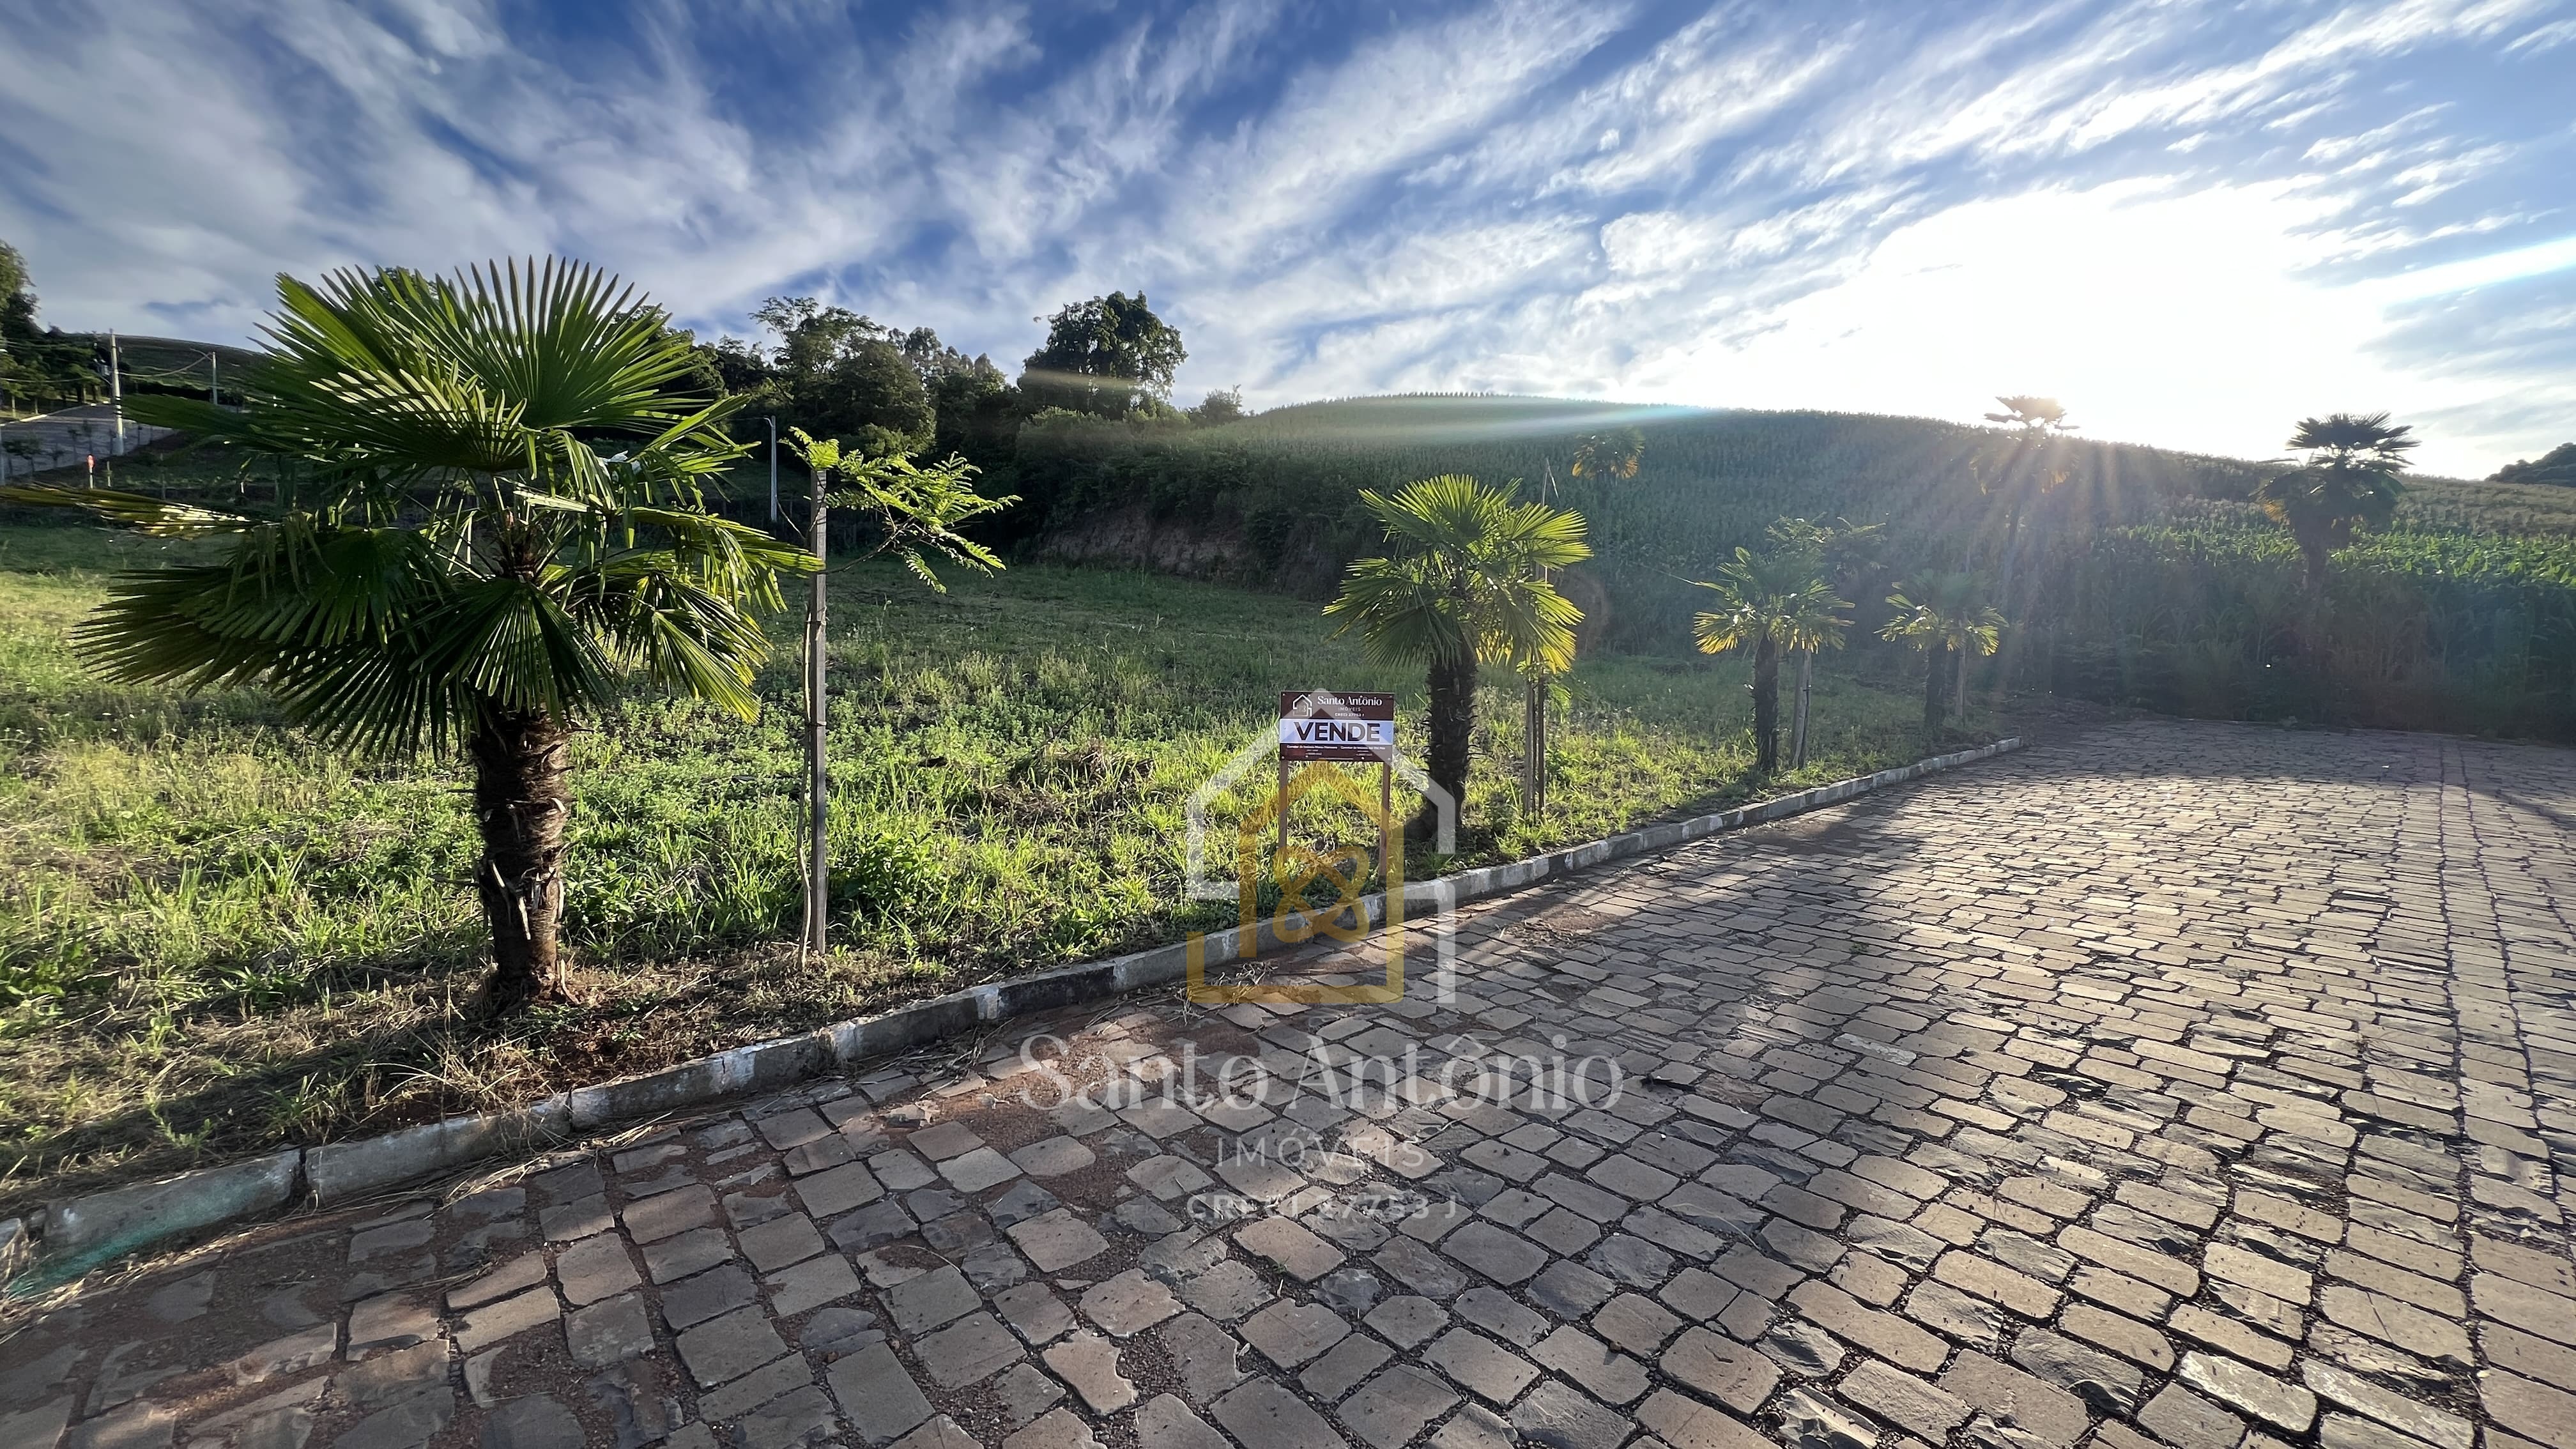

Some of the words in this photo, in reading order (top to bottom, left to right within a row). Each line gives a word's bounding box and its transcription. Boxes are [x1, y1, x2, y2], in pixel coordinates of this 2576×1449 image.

[1317, 695, 1345, 705] Santo
[1346, 695, 1383, 706] Antônio
[1294, 722, 1381, 742] VENDE
